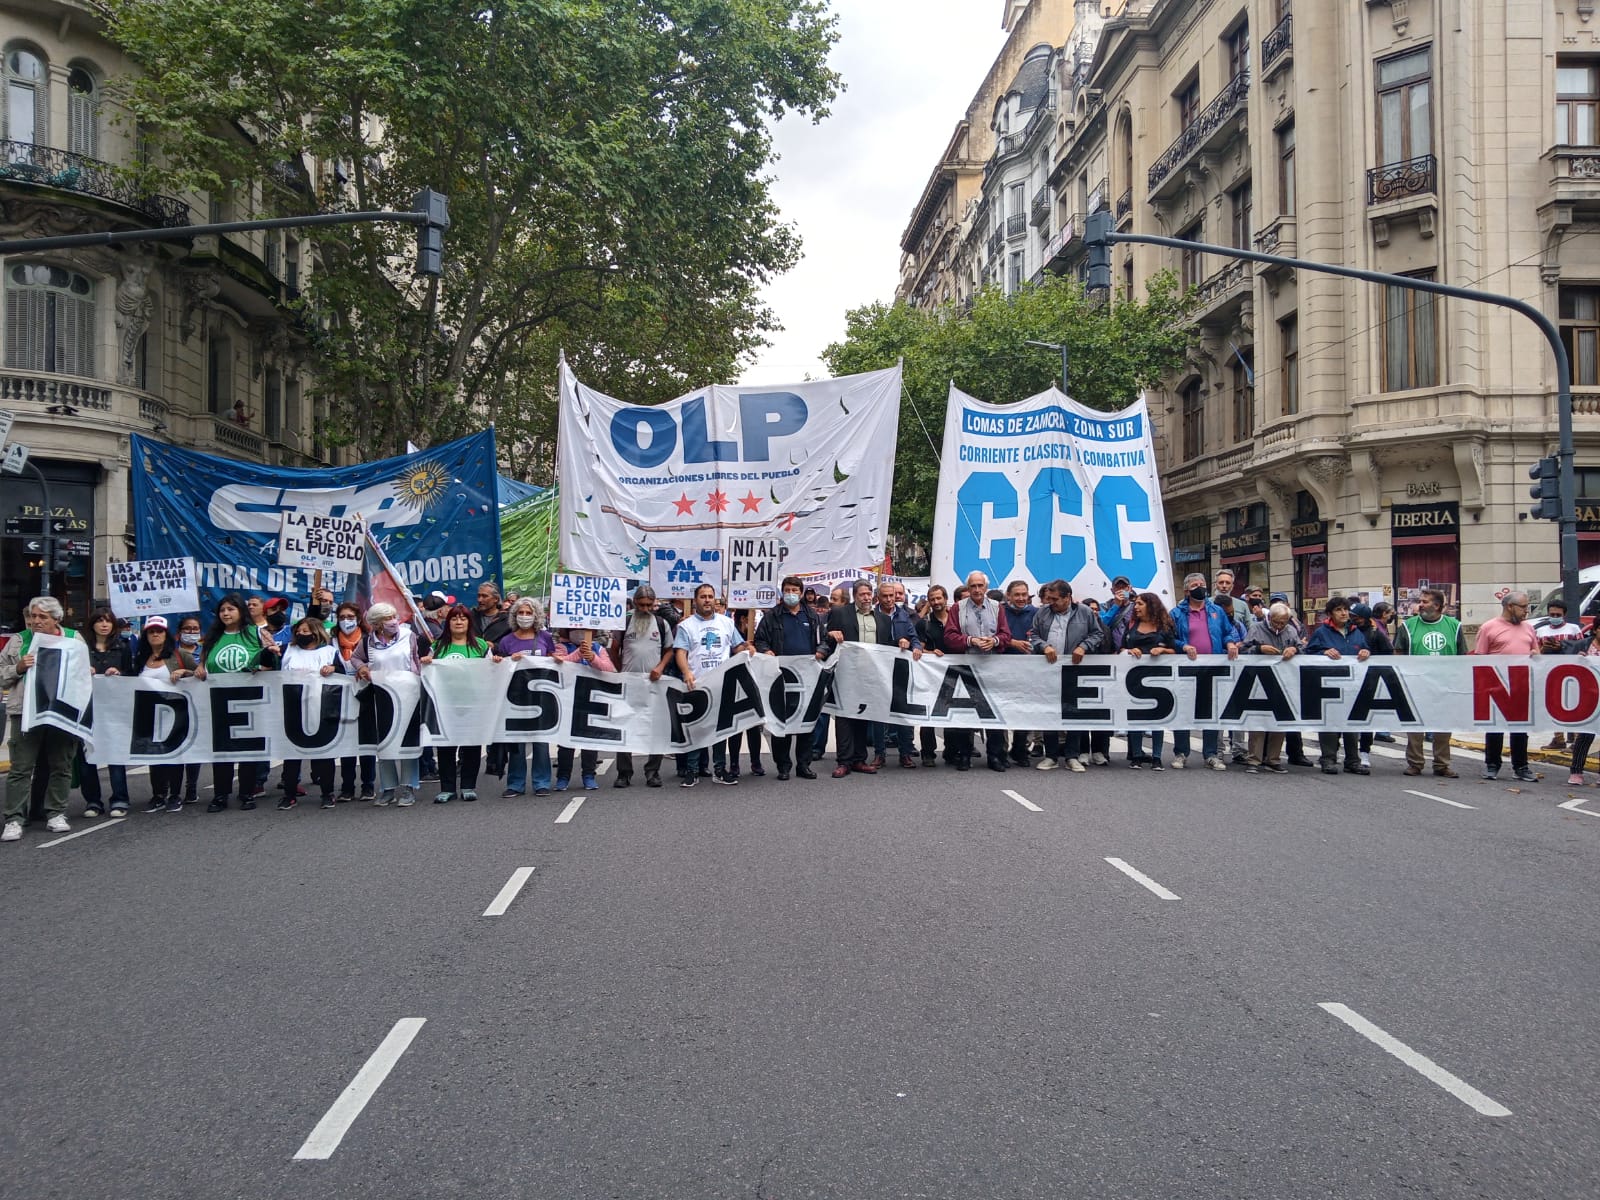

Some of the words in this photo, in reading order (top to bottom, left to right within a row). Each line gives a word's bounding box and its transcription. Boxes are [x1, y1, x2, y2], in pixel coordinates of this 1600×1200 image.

[610, 392, 808, 468] OLP
[967, 414, 1004, 433] LOMAS
[1008, 418, 1022, 432] DE
[1025, 412, 1065, 432] ZAMORA
[1073, 418, 1103, 438] ZONA
[1108, 421, 1134, 438] SUR
[959, 445, 1019, 463] CORRIENTE
[1023, 443, 1072, 461] CLASISTA
[1083, 450, 1146, 468] COMBATIVA
[618, 474, 704, 485] ORGANIZACIONES
[706, 472, 739, 481] LIBRES
[741, 472, 760, 480] DEL
[762, 468, 800, 480] PUEBLO
[1407, 482, 1441, 496] BAR
[288, 513, 307, 526] LA
[313, 517, 363, 533] DEUDA
[1394, 510, 1455, 527] IBERIA
[953, 467, 1157, 589] CCC
[286, 538, 304, 552] EL
[308, 541, 363, 560] PUEBLO
[734, 540, 753, 557] NO
[758, 541, 776, 557] AL
[111, 563, 133, 573] LAS
[672, 559, 696, 571] AL
[732, 559, 772, 581] FMI
[149, 569, 186, 580] PAGAN
[267, 568, 298, 592] DE
[554, 575, 570, 587] LA
[576, 576, 620, 590] DEUDA
[667, 571, 703, 583] FMI
[143, 581, 156, 591] AL
[756, 590, 775, 600] UTEP
[575, 603, 622, 617] PUEBLO
[1423, 632, 1446, 650] ATE
[218, 646, 247, 670] ATE
[35, 647, 93, 730] L
[130, 678, 442, 756] DEUDA
[505, 668, 623, 741] SE
[890, 657, 997, 719] LA
[1061, 665, 1417, 721] ESTAFA
[1473, 664, 1599, 722] NO
